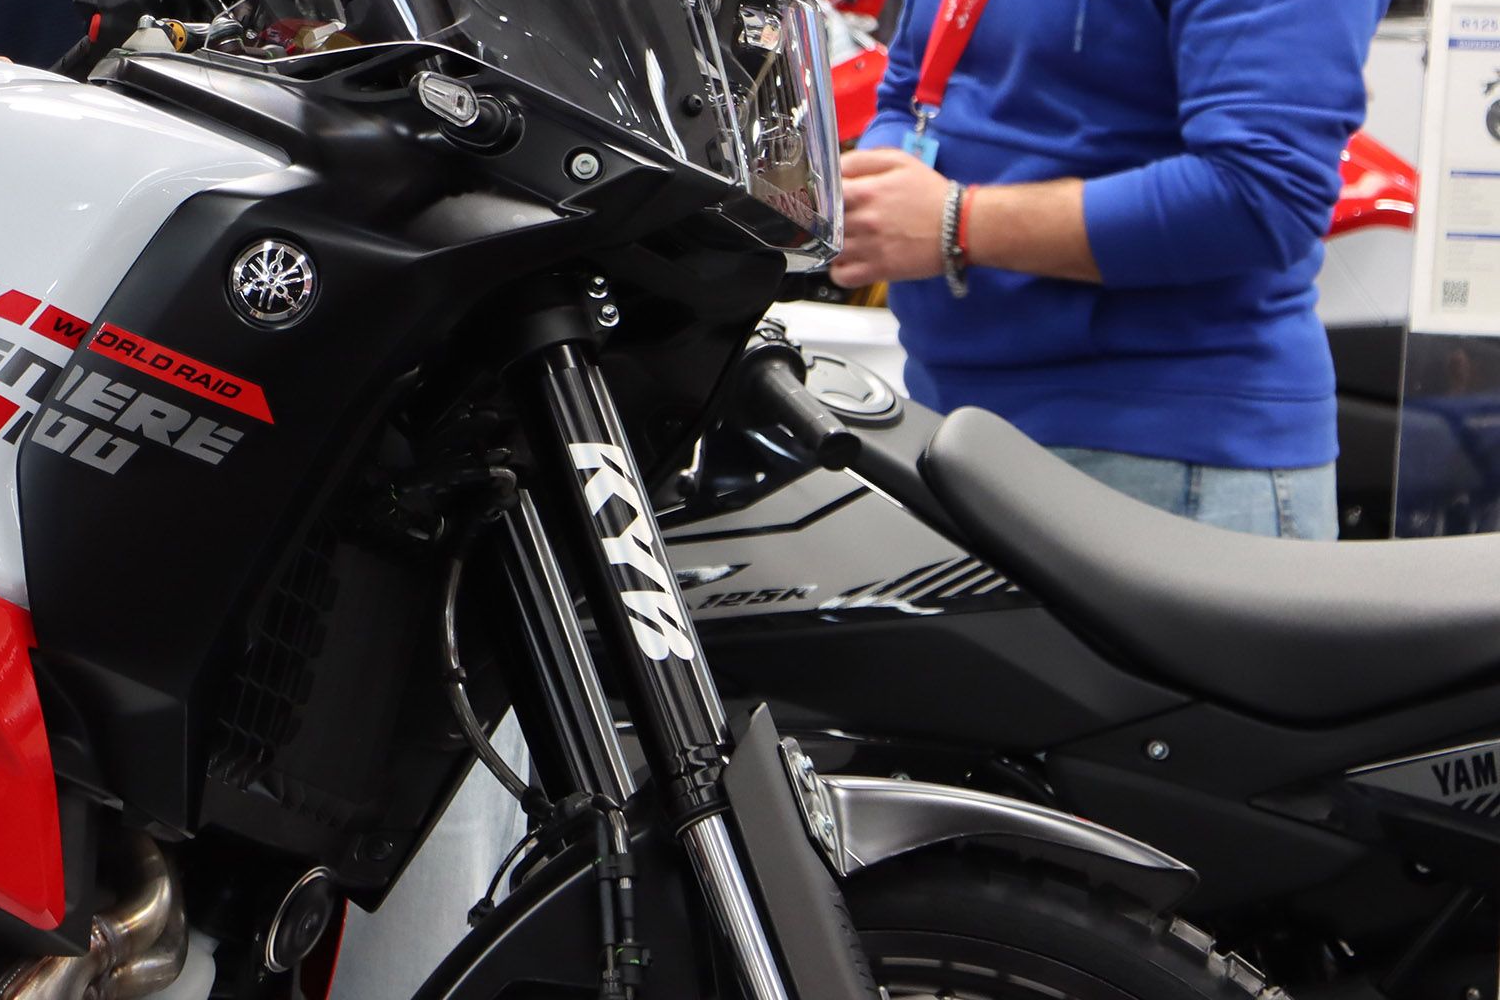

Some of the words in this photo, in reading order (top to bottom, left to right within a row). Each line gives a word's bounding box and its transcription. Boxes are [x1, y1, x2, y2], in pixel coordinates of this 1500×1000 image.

[51, 316, 174, 373] WORLD
[173, 363, 243, 400] RAID
[568, 442, 695, 661] KYB
[1431, 751, 1499, 797] YAM
